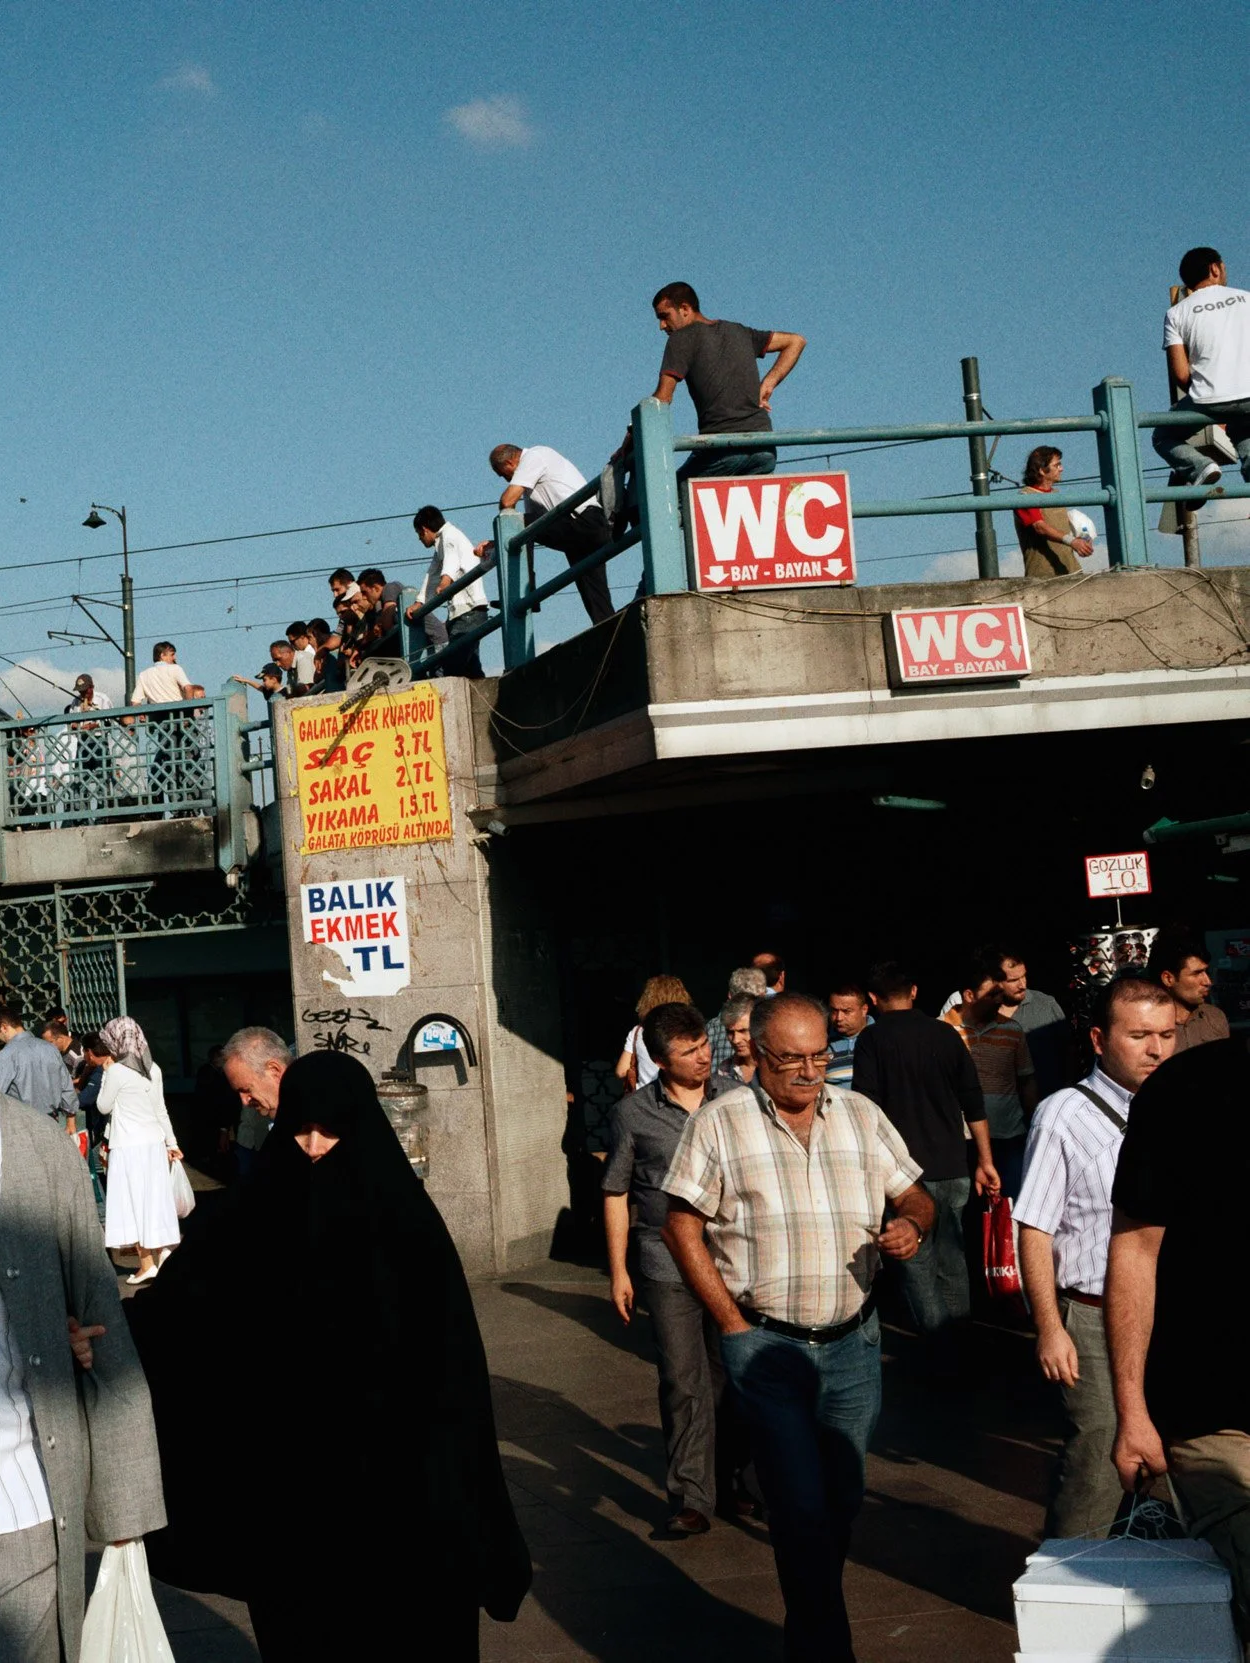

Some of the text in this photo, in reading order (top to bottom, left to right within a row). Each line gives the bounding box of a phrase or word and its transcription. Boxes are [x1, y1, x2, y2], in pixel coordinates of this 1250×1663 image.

[697, 480, 845, 562] WC
[730, 564, 758, 582] BAY
[775, 560, 822, 580] BAYAN
[899, 612, 1005, 662] WC
[908, 662, 939, 678] BAY
[954, 659, 1007, 675] BAYAN
[299, 715, 339, 742] GALATA
[382, 694, 435, 730] KUAFÖRÜ
[303, 731, 432, 771] SAÇ 3.TL
[309, 761, 434, 806] SAKAL 2.TL
[306, 791, 438, 834] YIKAMA 1.5.TL
[308, 819, 451, 850] GALATA KÖPRÜSÜ ALTINDA
[308, 881, 397, 913] BALIK
[310, 911, 400, 944] EKMEK
